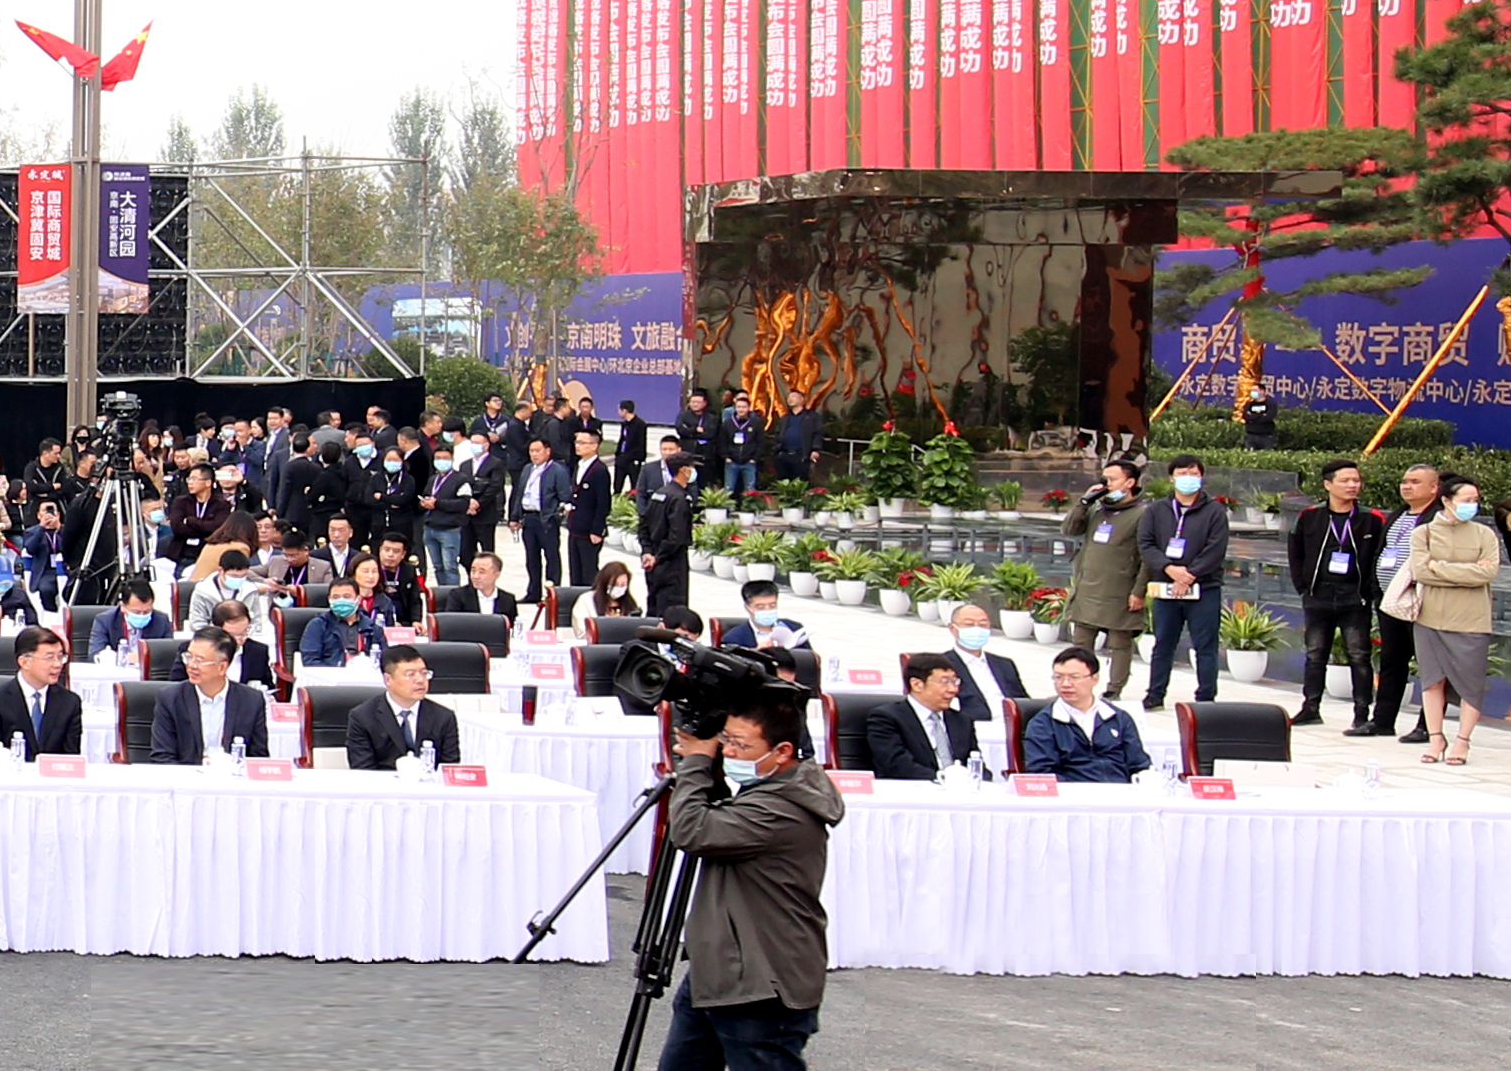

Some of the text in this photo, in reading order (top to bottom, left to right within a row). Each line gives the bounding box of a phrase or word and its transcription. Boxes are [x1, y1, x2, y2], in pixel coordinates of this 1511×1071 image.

[29, 191, 44, 260] 京津冀固安
[47, 190, 62, 260] 国际商贸城
[566, 321, 622, 351] 京南明珠
[1335, 321, 1470, 367] 数字商贸
